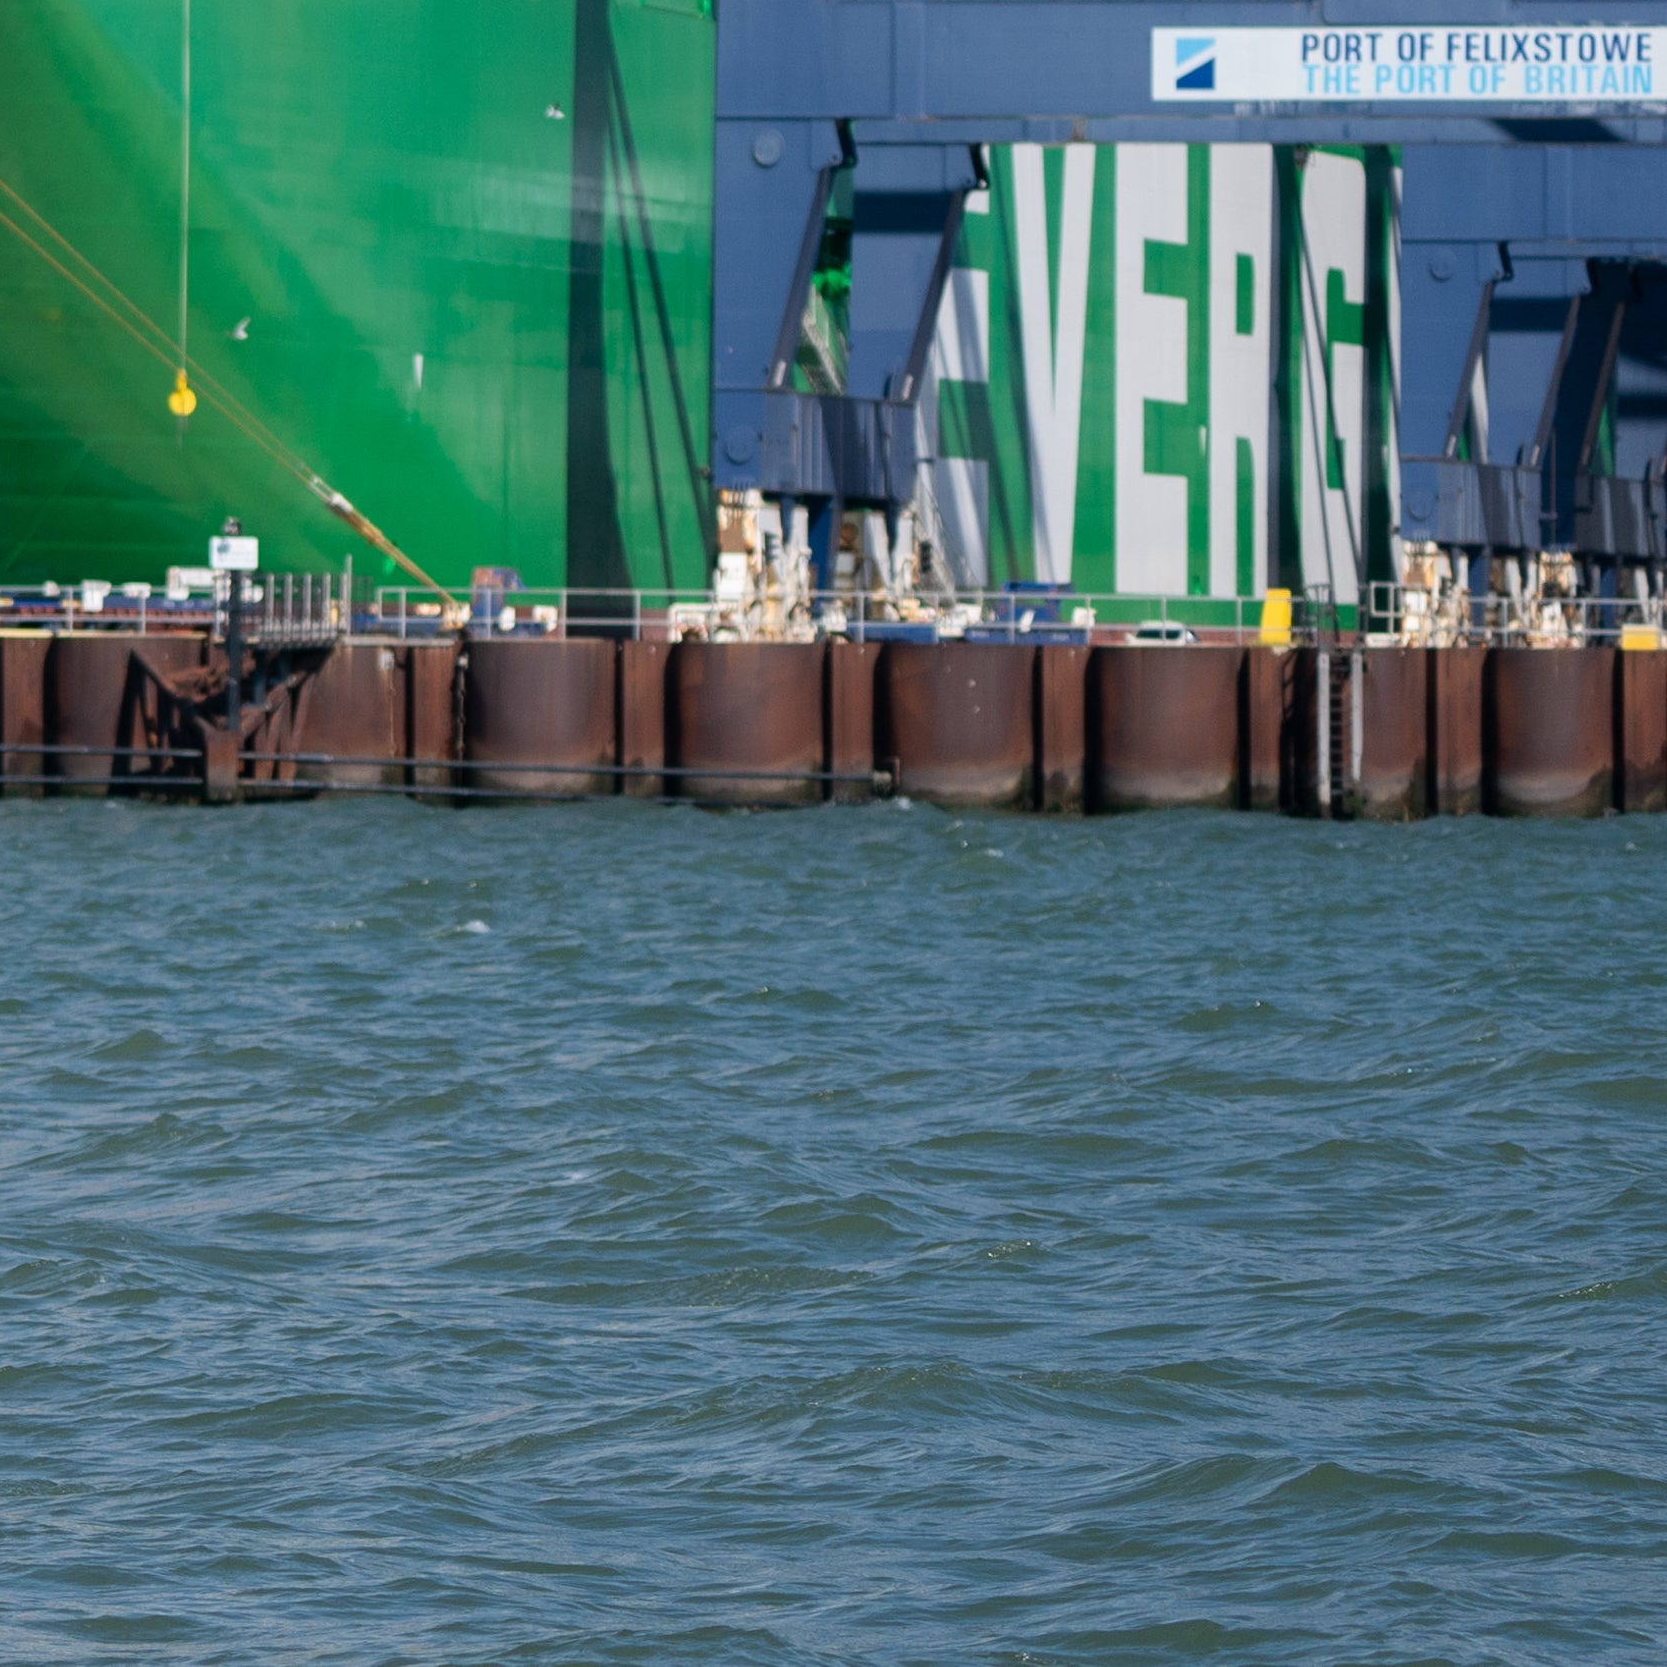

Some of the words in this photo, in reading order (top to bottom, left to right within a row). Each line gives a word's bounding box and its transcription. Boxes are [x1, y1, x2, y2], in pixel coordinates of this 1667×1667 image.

[1302, 33, 1382, 62] PORT
[1398, 33, 1435, 62] OF
[1447, 33, 1652, 62] FELIXSTOWE
[1304, 65, 1359, 94] THE
[1376, 65, 1457, 94] PORT
[1469, 65, 1505, 94] OF
[1525, 65, 1652, 94] BRITAIN
